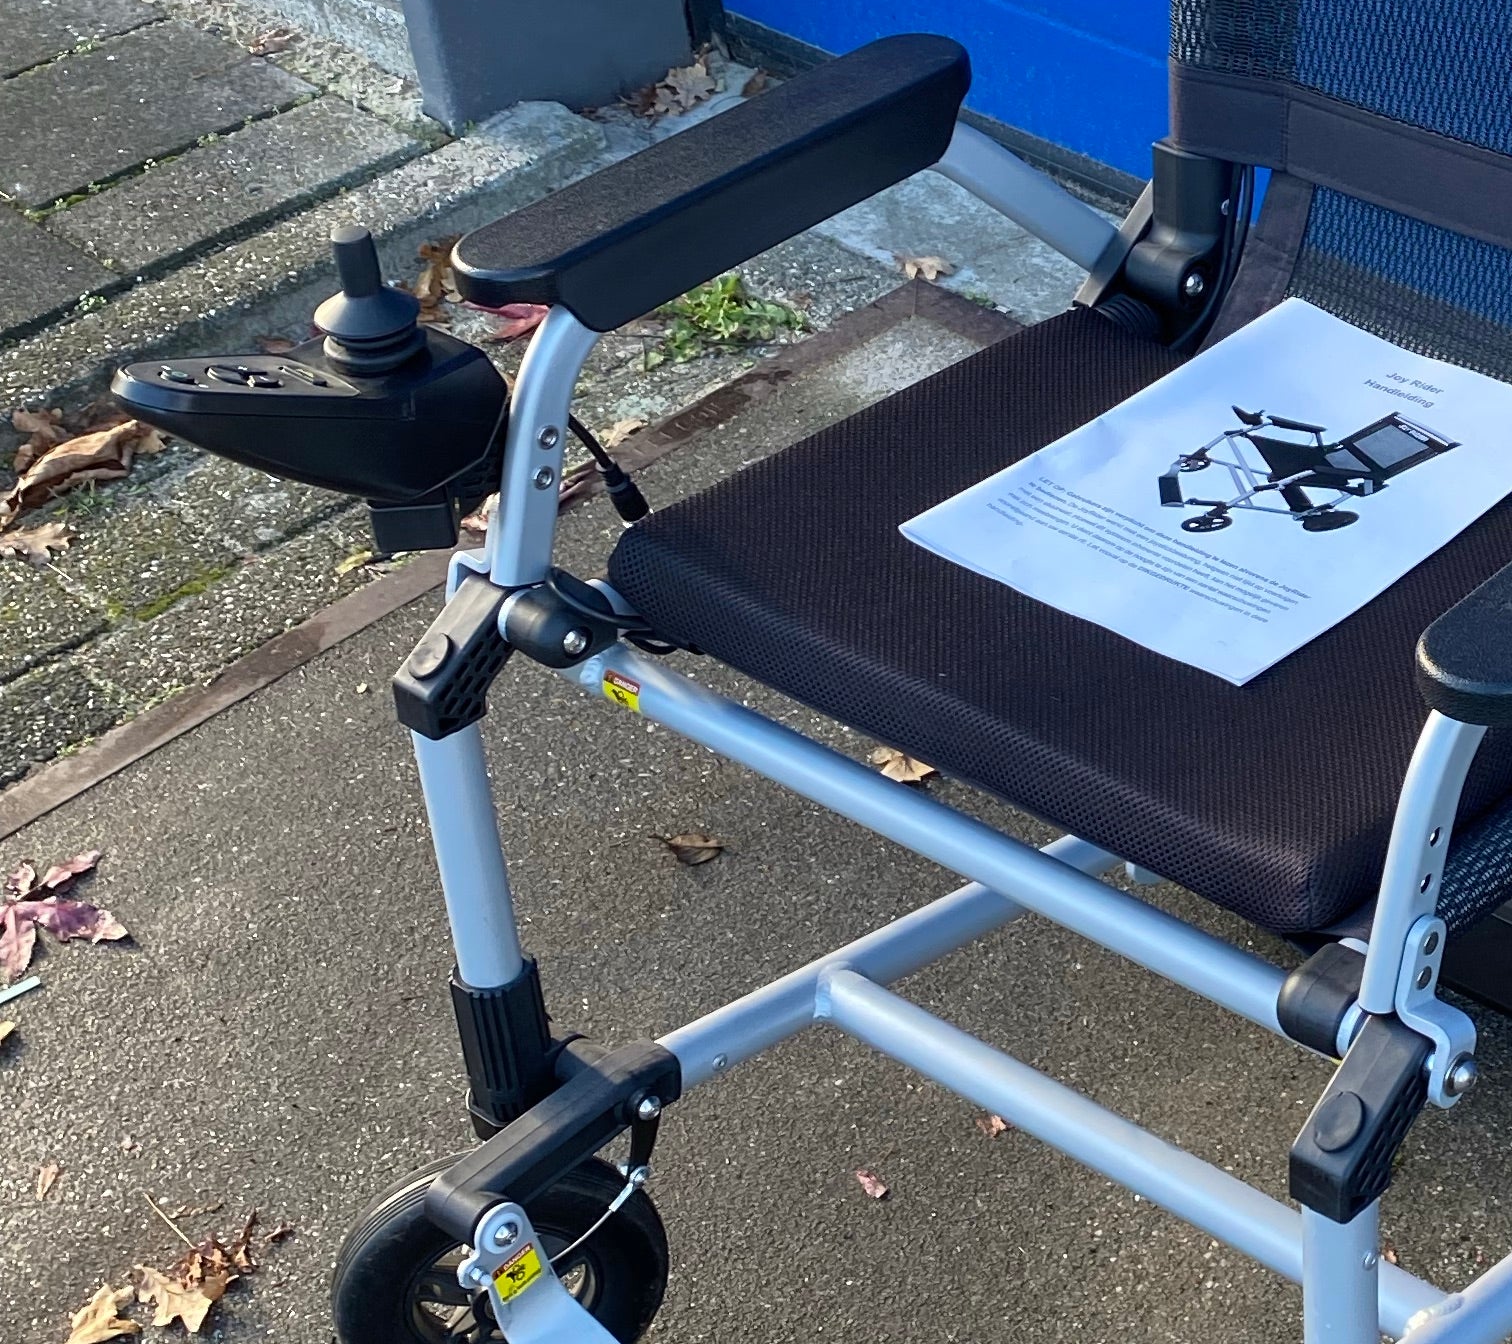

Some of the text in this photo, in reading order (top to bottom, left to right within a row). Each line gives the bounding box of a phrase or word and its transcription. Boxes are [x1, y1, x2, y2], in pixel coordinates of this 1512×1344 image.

[1364, 378, 1434, 408] Handleiding
[1386, 372, 1444, 394] Joy Rider
[503, 1245, 531, 1270] DANGER
